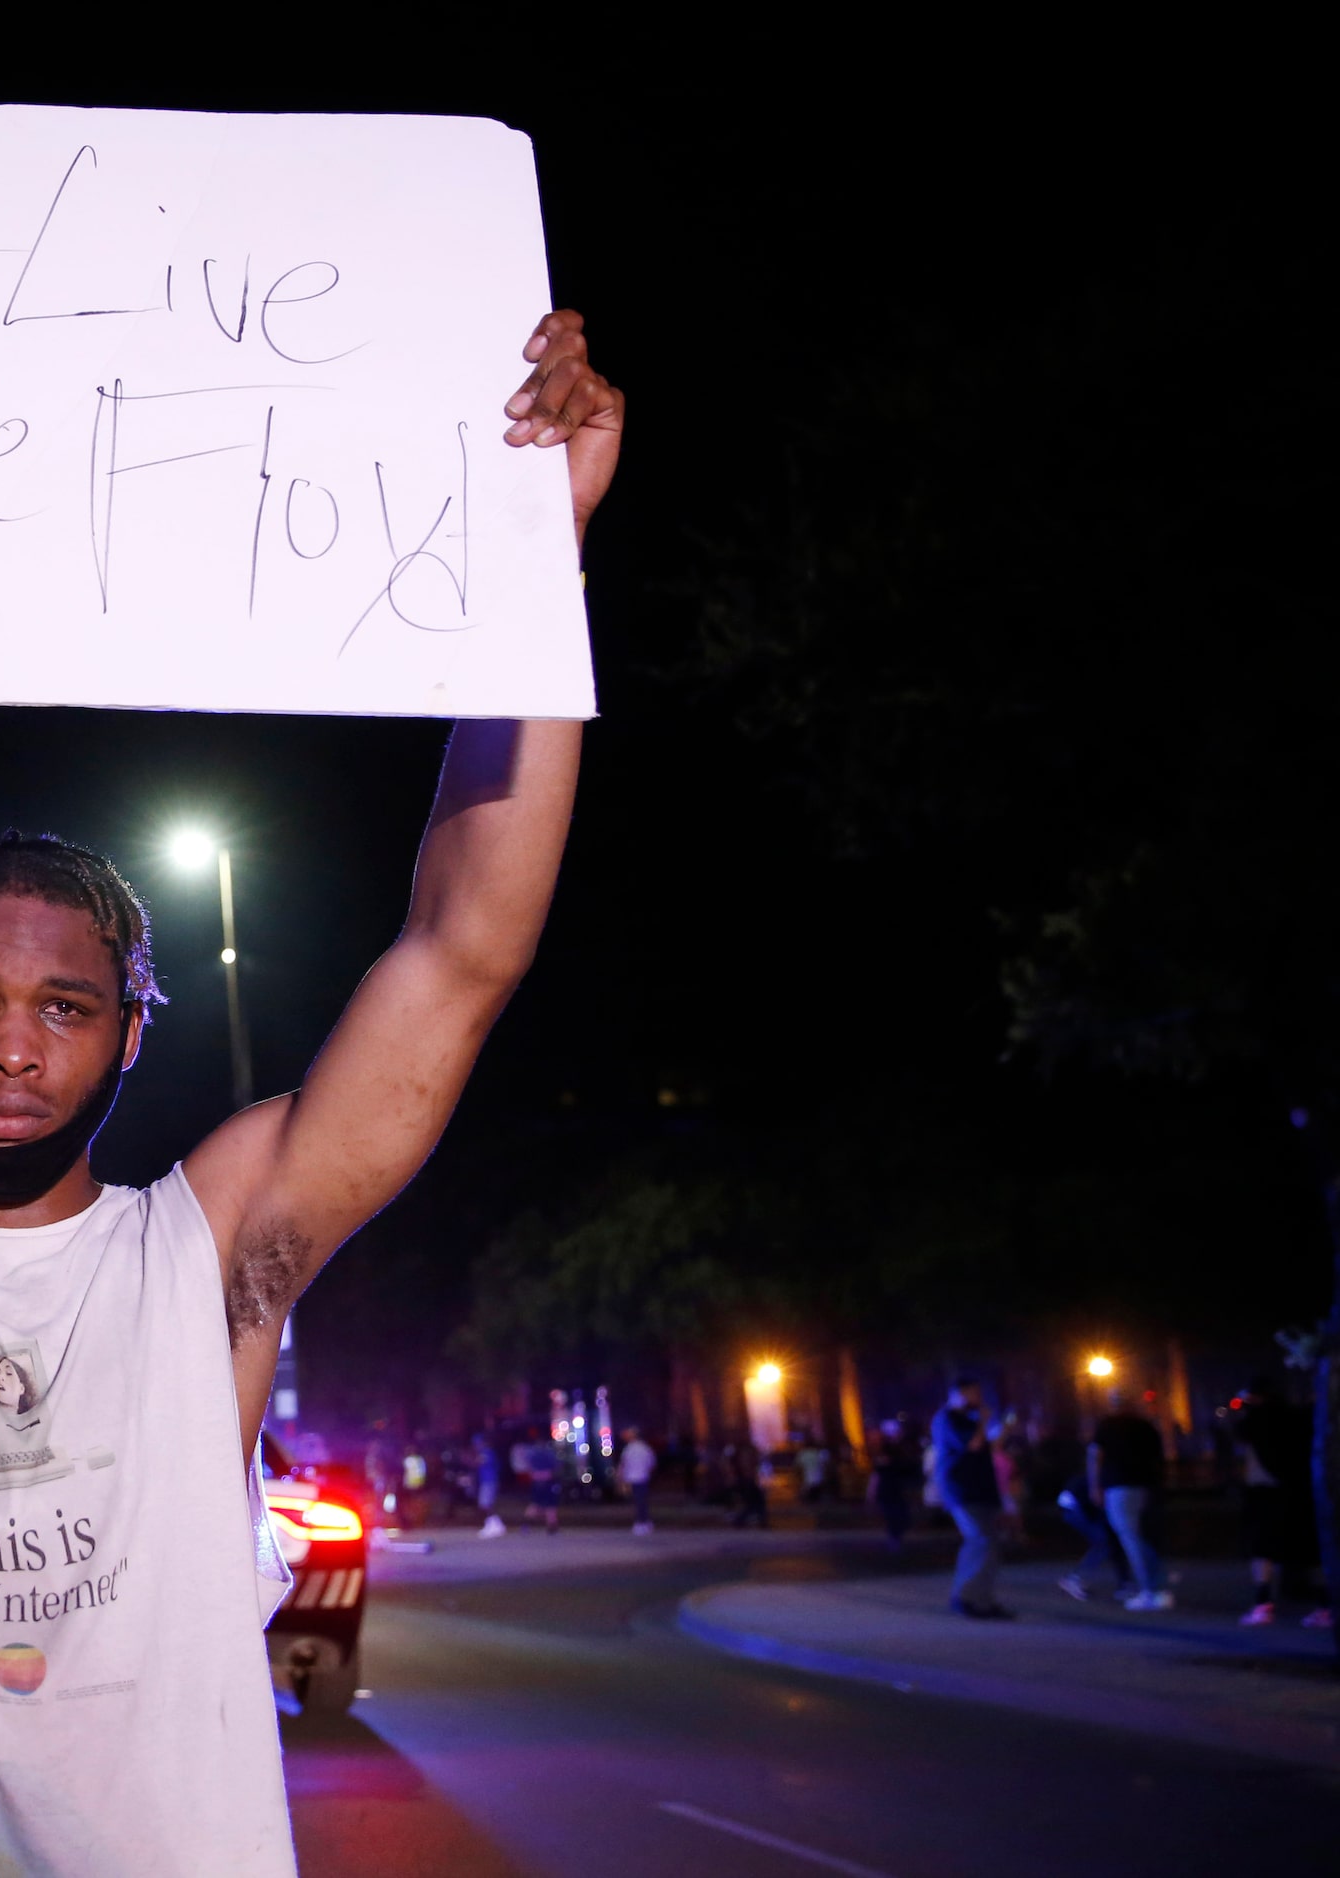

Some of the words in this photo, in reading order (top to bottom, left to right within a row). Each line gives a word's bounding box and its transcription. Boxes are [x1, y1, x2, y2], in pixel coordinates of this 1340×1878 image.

[2, 144, 371, 366] Live
[90, 376, 482, 659] Floyd
[55, 1508, 97, 1567] is
